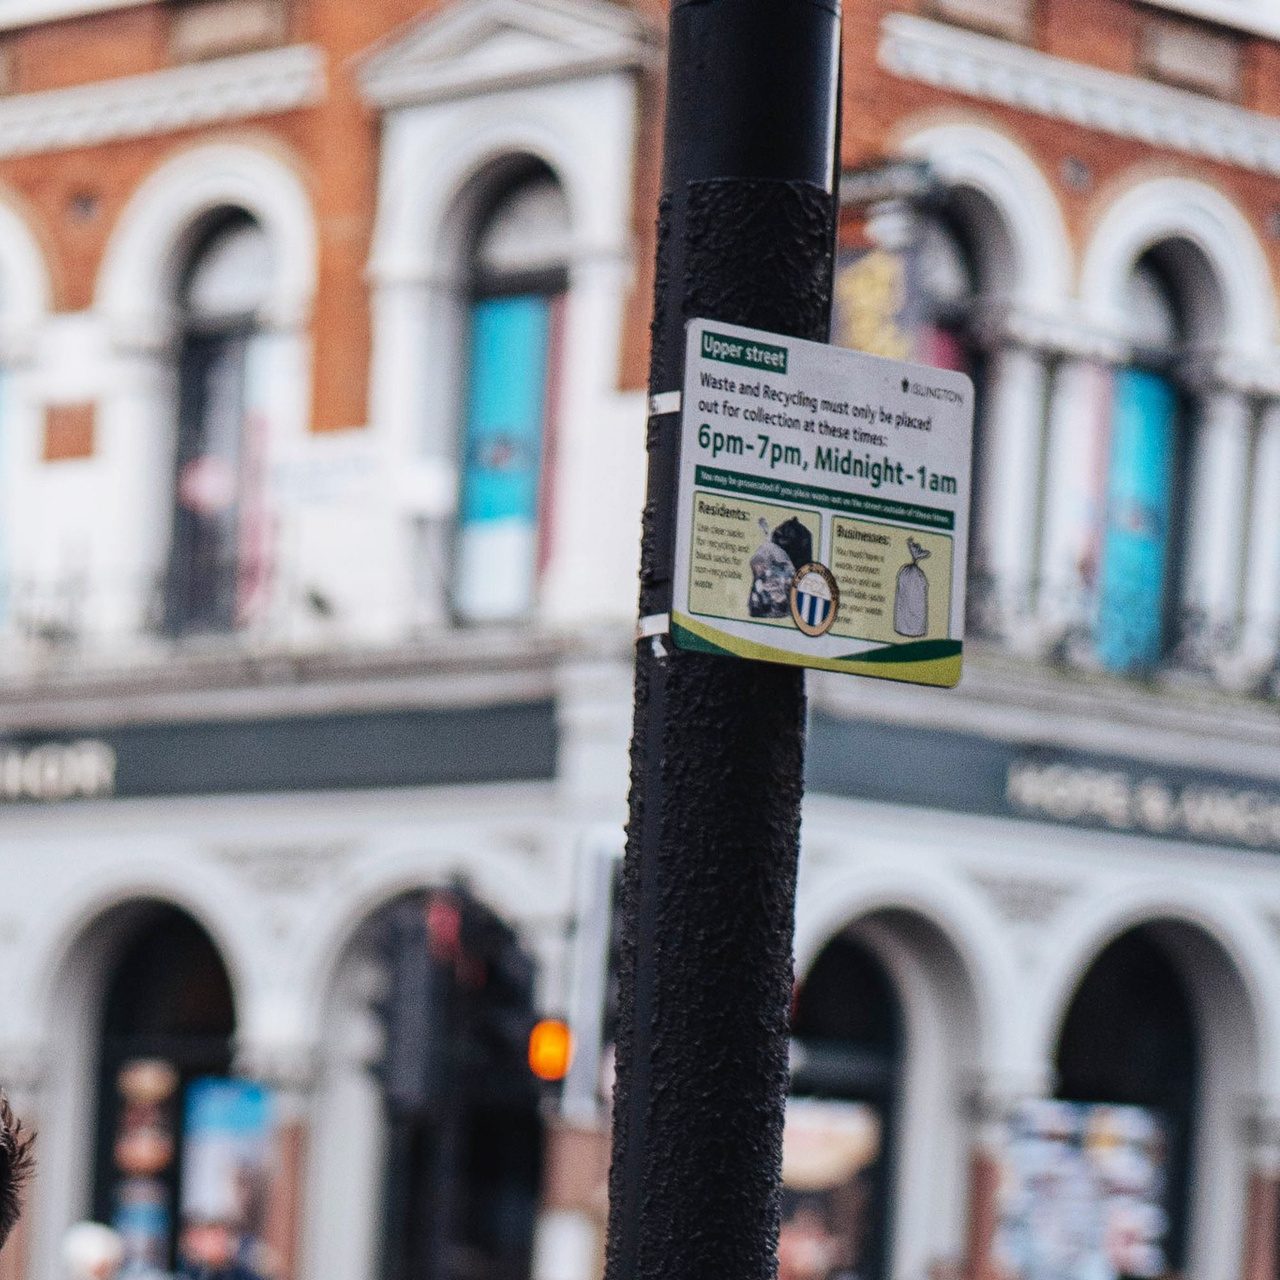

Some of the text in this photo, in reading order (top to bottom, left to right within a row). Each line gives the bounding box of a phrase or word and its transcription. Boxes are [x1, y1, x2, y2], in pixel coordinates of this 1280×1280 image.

[703, 334, 785, 367] Upper street
[698, 399, 888, 446] out for collection at these times:
[700, 371, 932, 432] Waste and Recycling must only be placed
[814, 445, 957, 495] Midnight-1am
[698, 500, 751, 521] Residents:
